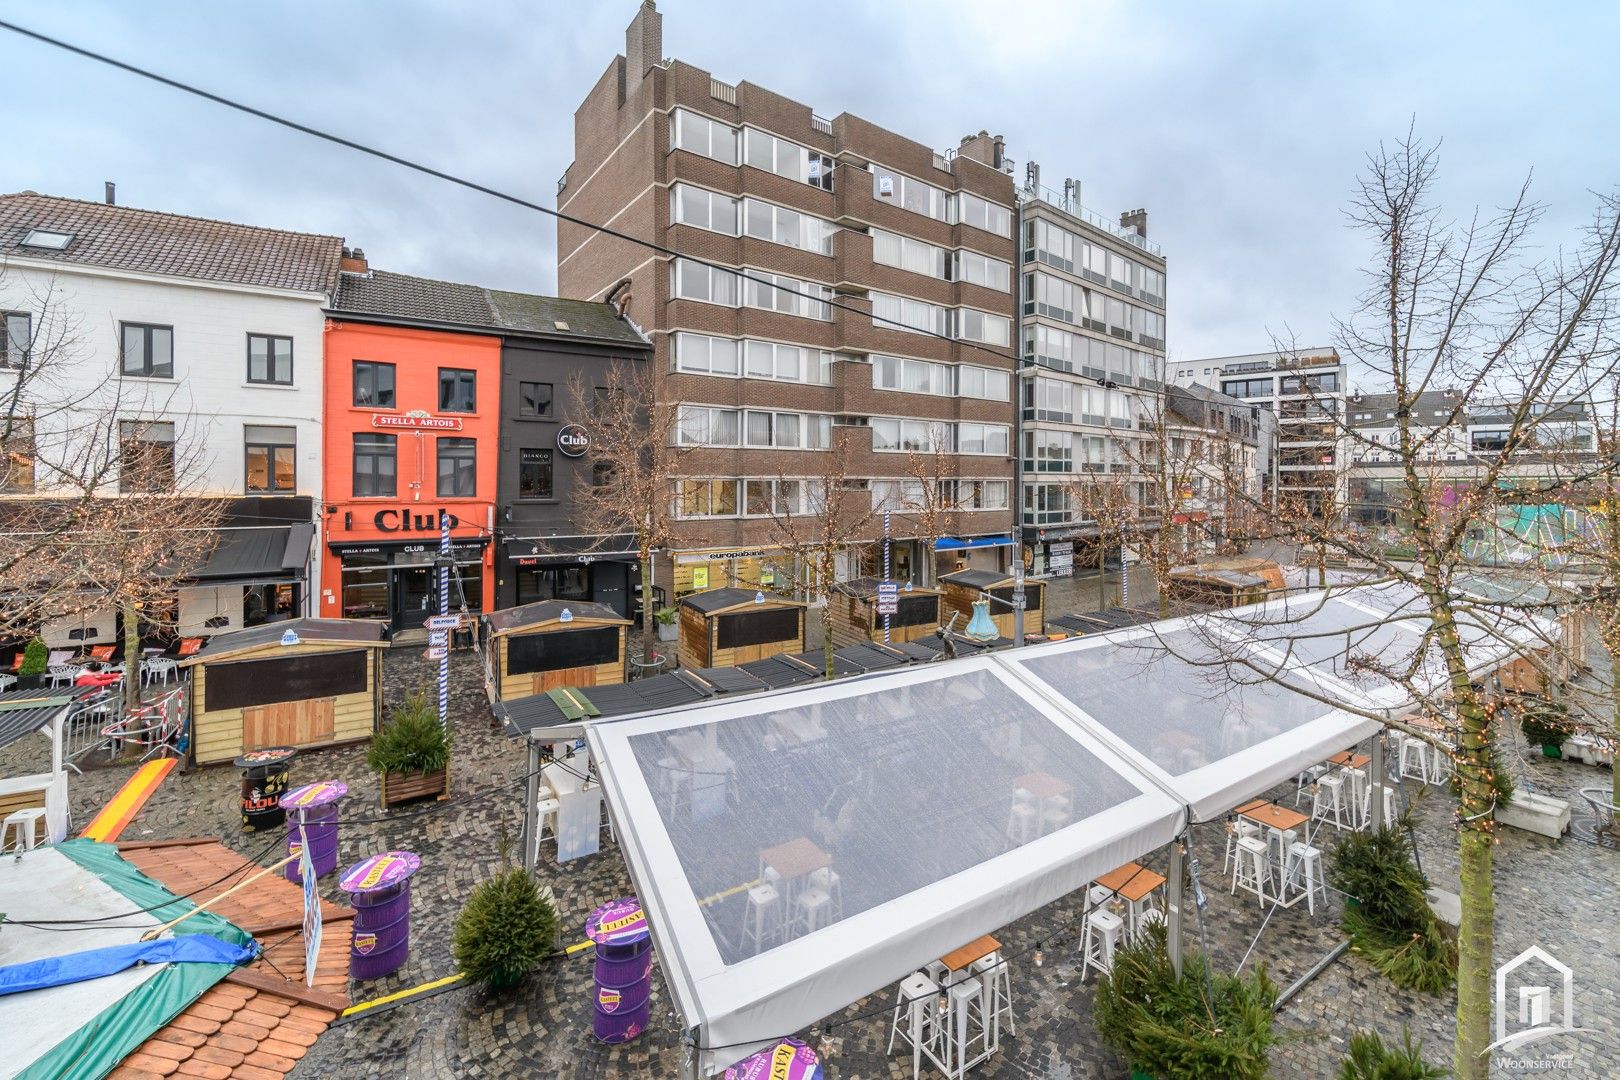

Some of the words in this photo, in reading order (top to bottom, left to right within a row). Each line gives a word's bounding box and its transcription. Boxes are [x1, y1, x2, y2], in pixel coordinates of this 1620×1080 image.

[381, 417, 415, 426] STELLA
[421, 418, 454, 427] ARTOIS
[560, 435, 588, 445] Club
[374, 508, 459, 533] Club
[605, 912, 643, 932] ASTEEL
